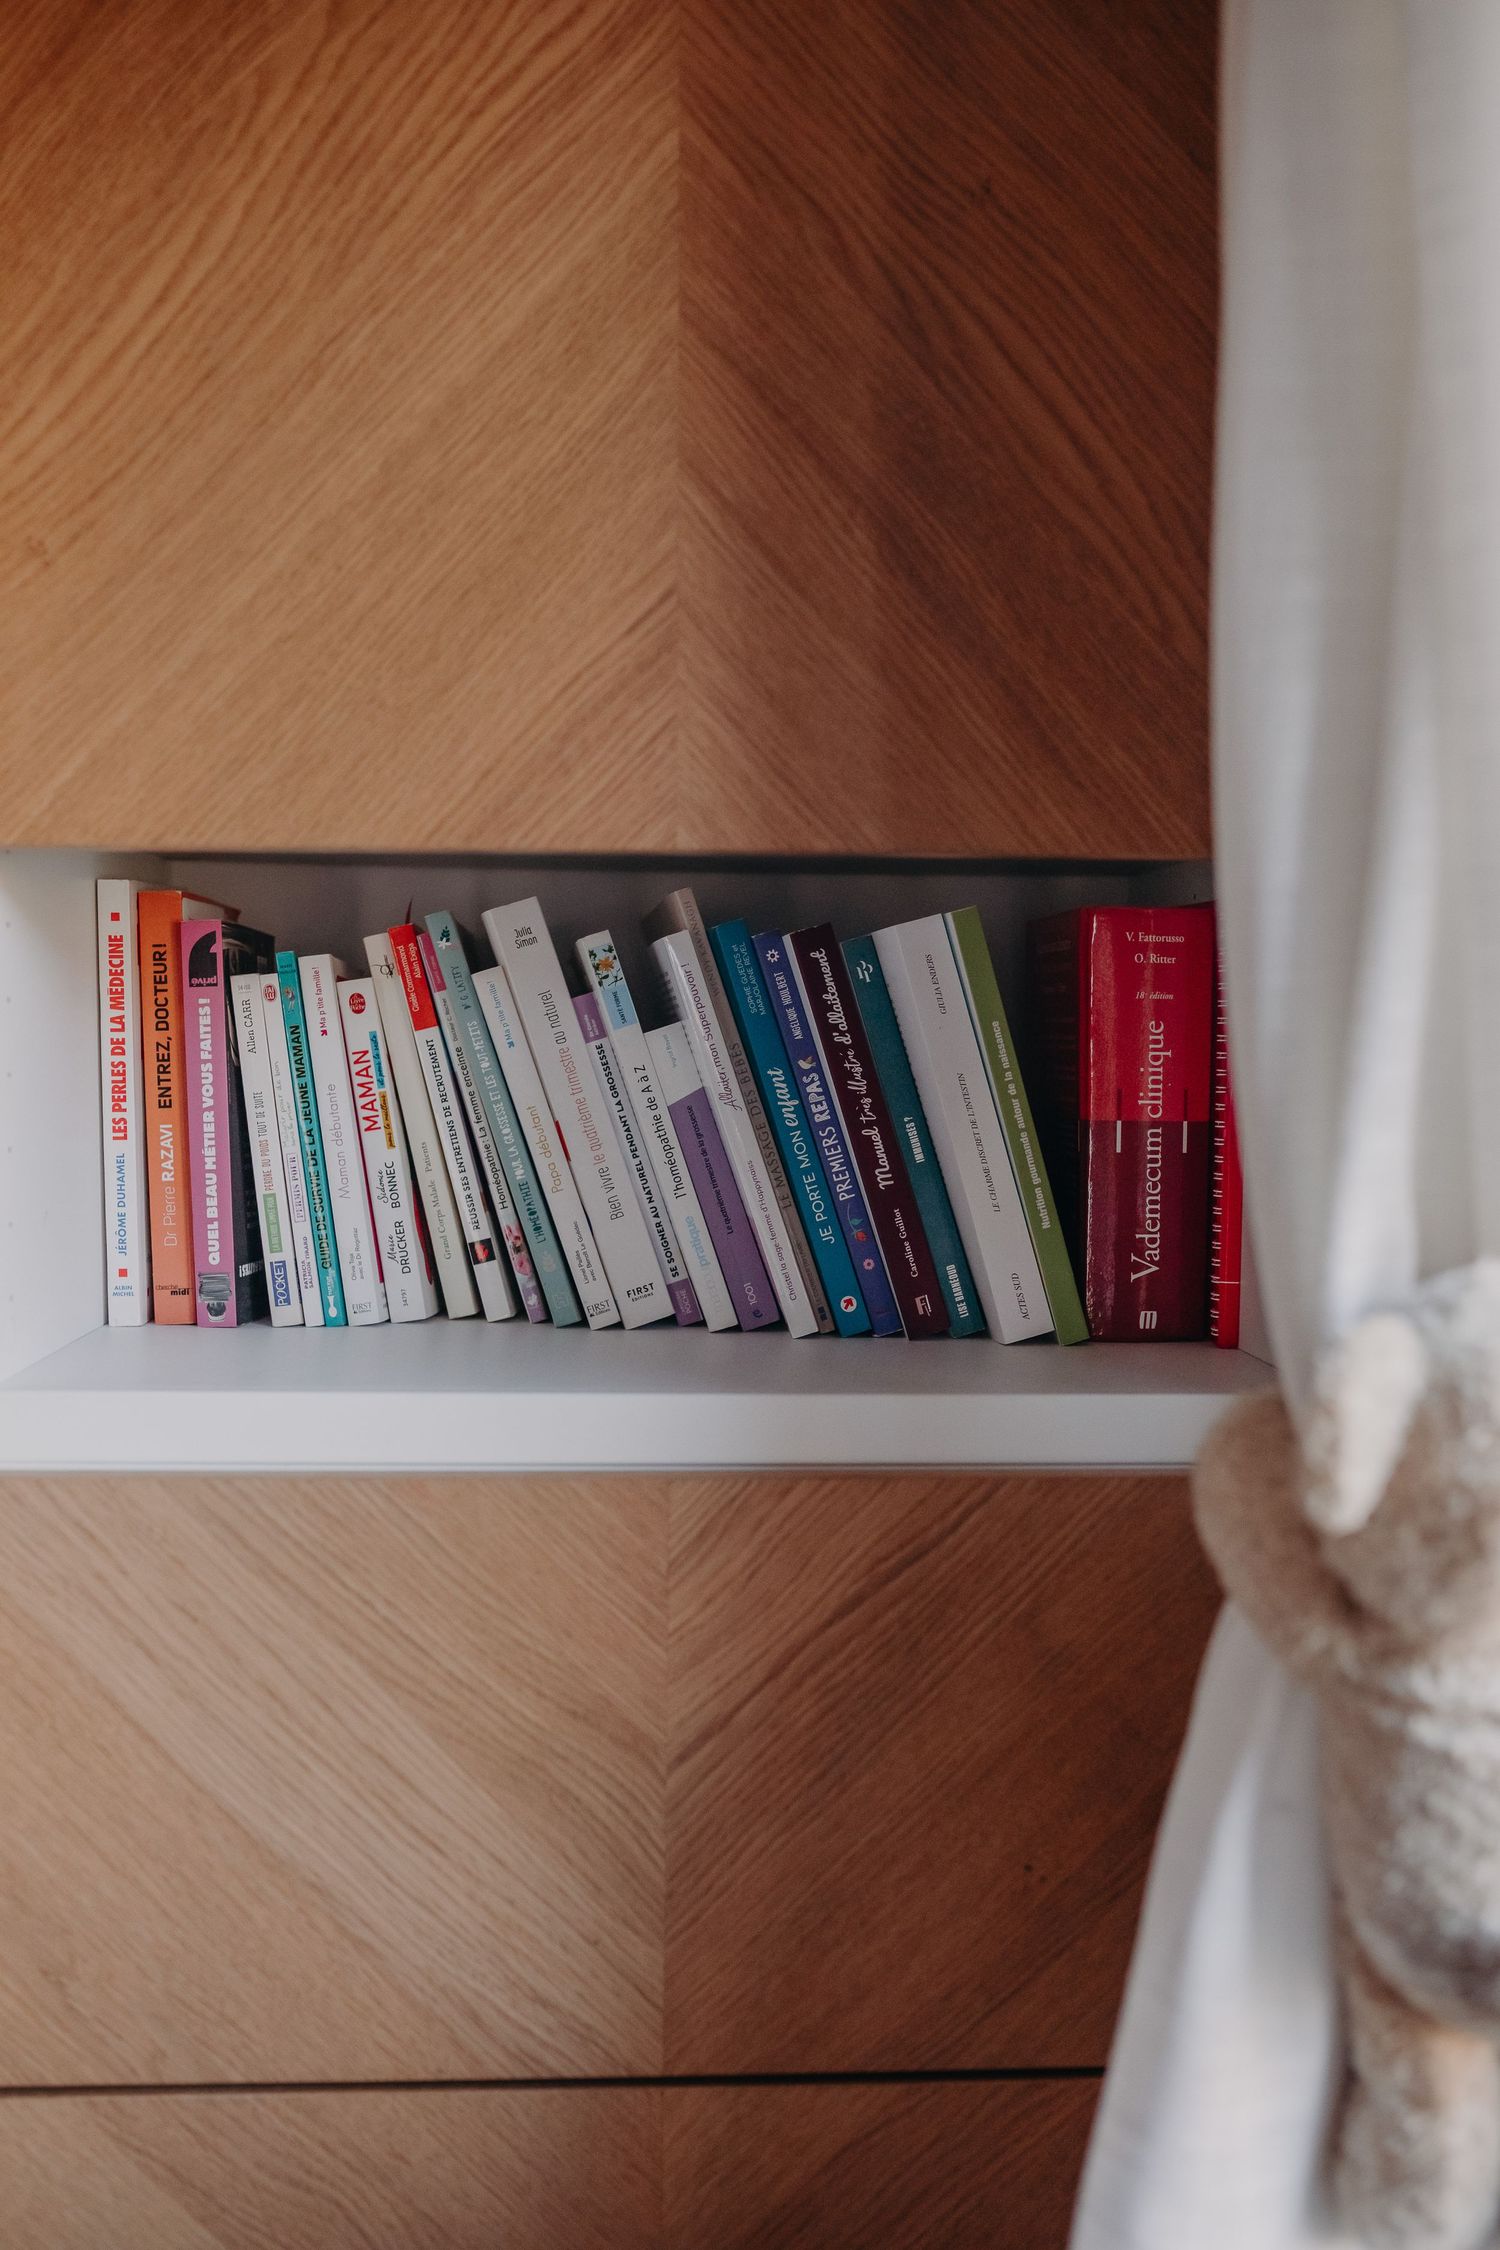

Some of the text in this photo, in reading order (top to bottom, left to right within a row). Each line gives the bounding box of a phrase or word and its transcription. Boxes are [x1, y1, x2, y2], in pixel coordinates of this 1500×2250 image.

[513, 926, 533, 939] Julia
[515, 935, 538, 949] Simon
[1126, 932, 1185, 943] V. Fattorusso
[1134, 953, 1176, 964] O. Ritter
[743, 986, 758, 1014] SOPHIE
[746, 968, 767, 1016] MARJOLAINE
[773, 971, 792, 1006] HOULBERT
[924, 953, 947, 1015] GIULIA ENDERS
[1149, 991, 1174, 1000] édition
[110, 1015, 125, 1032] LA
[241, 999, 254, 1028] CARR
[683, 969, 714, 1042] Superpouvoir
[110, 1038, 126, 1056] DE
[248, 1029, 257, 1054] Allen
[289, 1024, 307, 1079] MAMAN
[467, 1020, 489, 1073] TOUT-PETITS
[708, 1044, 721, 1065] mon
[156, 1037, 172, 1109] ENTREZ,
[201, 1062, 214, 1108] VOUS
[455, 1047, 472, 1087] enceinte
[484, 1075, 497, 1089] LES
[809, 948, 895, 1190] Manuel très illustré d'allaitement
[111, 1060, 127, 1113] PERLES
[298, 1081, 312, 1124] JEUNE
[352, 1050, 382, 1132] MAMAN
[489, 1089, 501, 1101] ET
[537, 989, 625, 1221] Bien vivre le quatrième trimestre au naturel
[745, 1091, 762, 1117] DES
[468, 1090, 483, 1124] femme
[492, 1100, 515, 1145] GROSSESSE
[686, 1104, 704, 1141] grossesse
[992, 1020, 1051, 1229] Nutrition gourmande autour de la naissance
[112, 1117, 128, 1140] LES
[202, 1111, 217, 1169] MÉTIER
[253, 1091, 274, 1191] PERDRE DU POIDS TOUT DE SUITE
[305, 1128, 315, 1146] LA
[326, 1083, 351, 1200] Maman débutante
[425, 1039, 480, 1231] RÉUSSIR SES ENTRETIENS DE RECRUTEMENT
[478, 1127, 487, 1139] La
[634, 1064, 688, 1199] l'homéopathie de A à Z
[802, 1072, 855, 1201] PREMIERS REPAS
[905, 1122, 926, 1164] IMMUNISÉS
[957, 1072, 1001, 1213] LE CHARME DISCRET DE L'INTESTIN
[307, 1149, 318, 1166] DE
[421, 1142, 432, 1173] Patients
[507, 1145, 519, 1158] LA
[526, 1105, 564, 1195] Papa débutant
[594, 1043, 680, 1278] SE SOIGNER AU NATUREL PENDANT LA GROSSESSE
[699, 1147, 708, 1158] de
[755, 1124, 786, 1188] MASSAGE
[767, 1067, 835, 1244] JE PORTE MON enfant
[1130, 1020, 1172, 1283] Vademecum clinique
[160, 1124, 177, 1246] Dr Pierre RAZAVI
[377, 1169, 389, 1203] Sidonie
[384, 1161, 401, 1209] BONNEC
[511, 1158, 526, 1180] POUR
[703, 1157, 719, 1190] trimestre
[115, 1153, 127, 1256] JÉRÔME DUHAMEL
[205, 1173, 219, 1219] BEAU
[309, 1170, 324, 1213] SURVIE
[714, 1189, 732, 1226] quatrième
[778, 1193, 792, 1209] LE
[314, 1216, 327, 1231] DE
[430, 1179, 451, 1260] Grand Corps Malade
[726, 1226, 734, 1235] Le
[765, 1213, 785, 1262] sage-femme
[207, 1222, 220, 1265] QUEL
[319, 1233, 332, 1270] GUIDE
[386, 1234, 399, 1264] Marie
[394, 1220, 412, 1274] DRUCKER
[685, 1215, 711, 1268] pratique
[893, 1208, 919, 1278] Caroline Guillot
[274, 1260, 288, 1306] POCKET
[301, 1260, 309, 1289] PATRICIA
[780, 1262, 786, 1271] la
[170, 1288, 190, 1296] midi
[626, 1282, 655, 1299] FIRST
[743, 1282, 758, 1305] 1001
[782, 1270, 797, 1301] Christel
[1011, 1272, 1031, 1320] ACTES SUD
[352, 1302, 372, 1310] FIRST
[586, 1299, 610, 1314] FIRST
[956, 1301, 969, 1318] LISE
